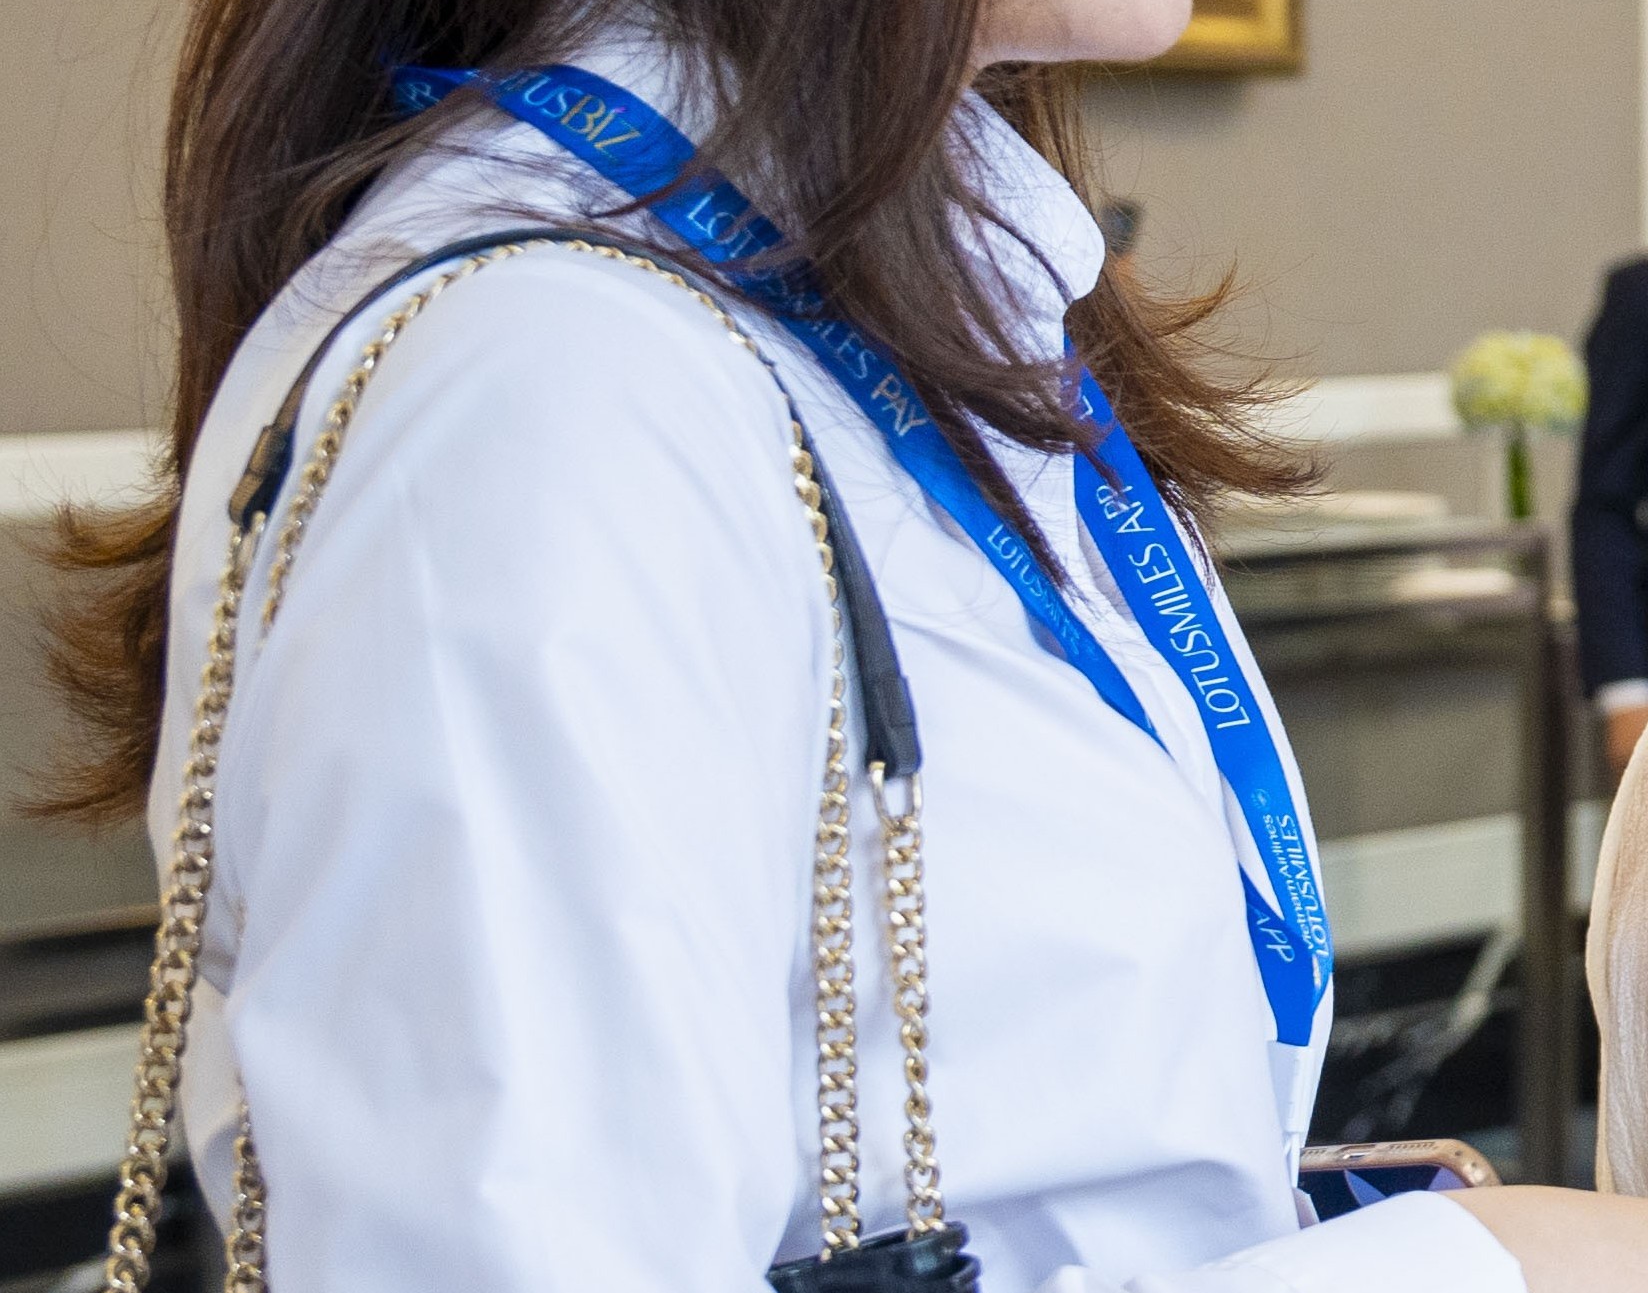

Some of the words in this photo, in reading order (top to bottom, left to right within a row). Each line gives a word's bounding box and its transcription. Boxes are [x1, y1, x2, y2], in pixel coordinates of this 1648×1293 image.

[685, 191, 881, 381] LOTILES
[871, 372, 929, 437] PAY
[1127, 544, 1251, 730] LOTUSMILES
[1250, 900, 1296, 963] APP
[1276, 813, 1331, 958] LOTUSMILES
